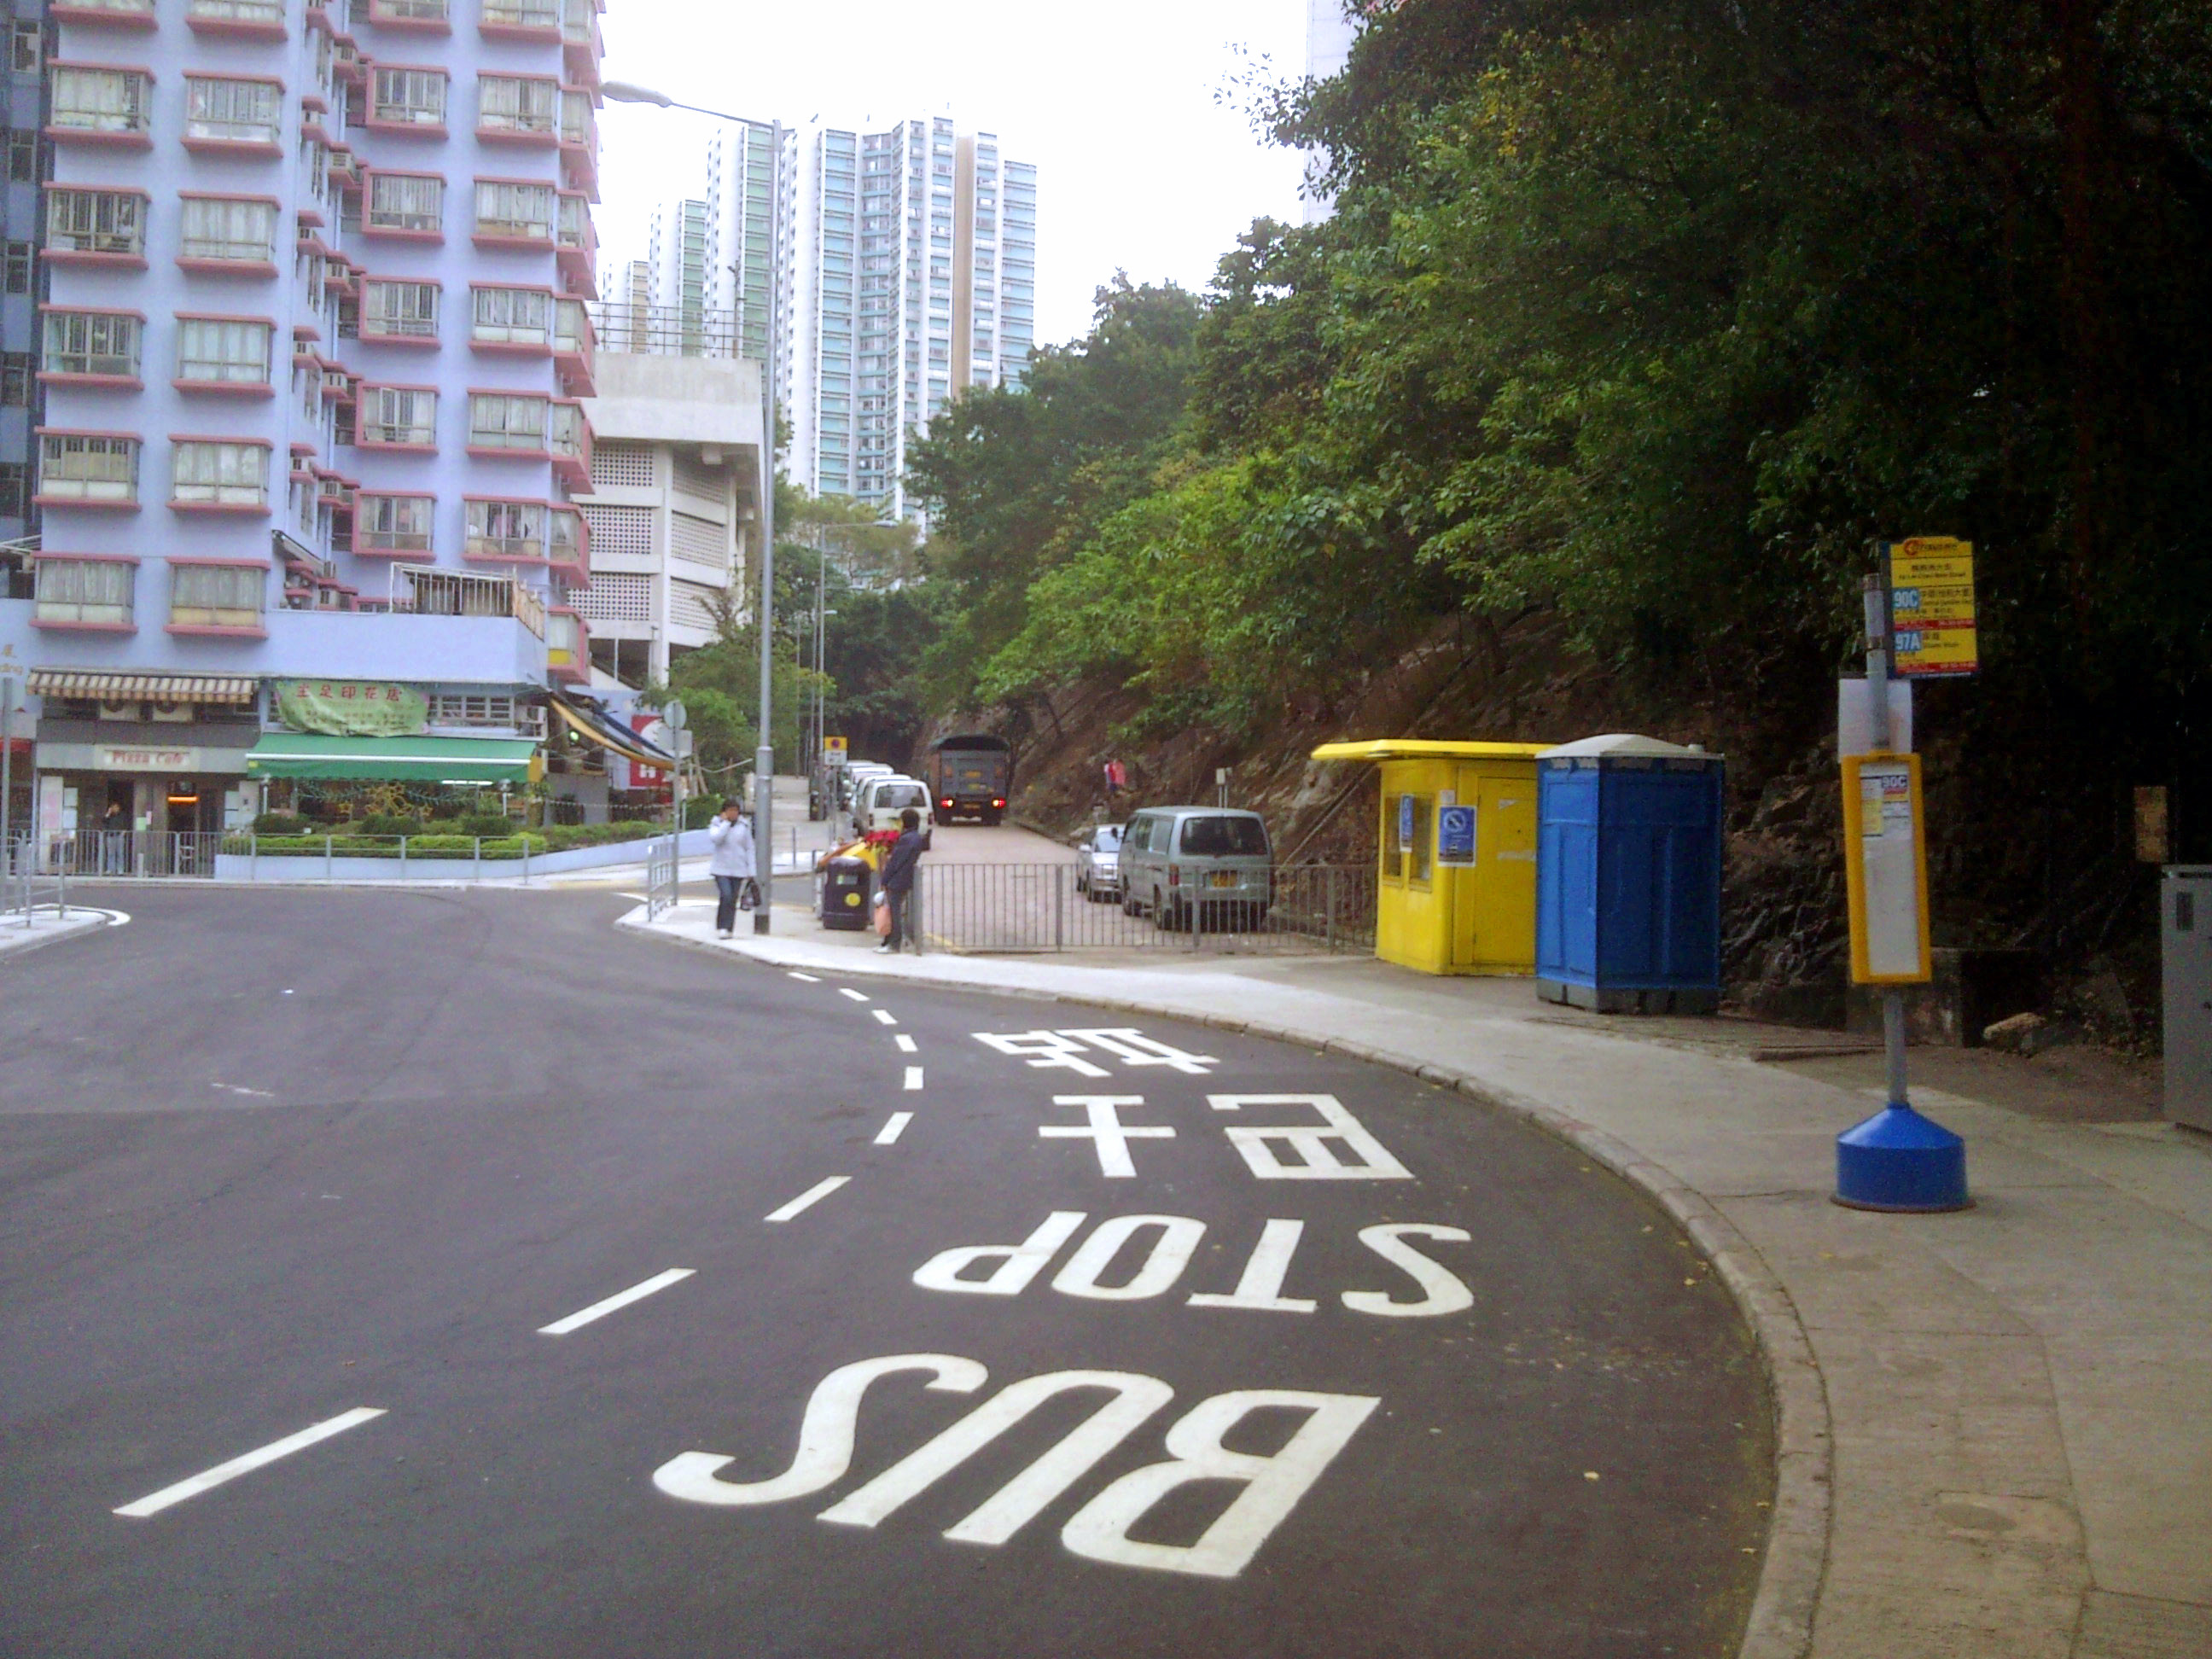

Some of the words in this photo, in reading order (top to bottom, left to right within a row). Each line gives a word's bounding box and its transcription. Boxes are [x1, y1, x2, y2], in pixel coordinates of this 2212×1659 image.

[1894, 590, 1918, 608] 90C
[1895, 632, 1920, 650] 97A
[1883, 776, 1906, 787] 90C
[971, 1027, 1220, 1077] 站
[911, 1210, 1474, 1317] STOP
[652, 1353, 1382, 1579] BUS
